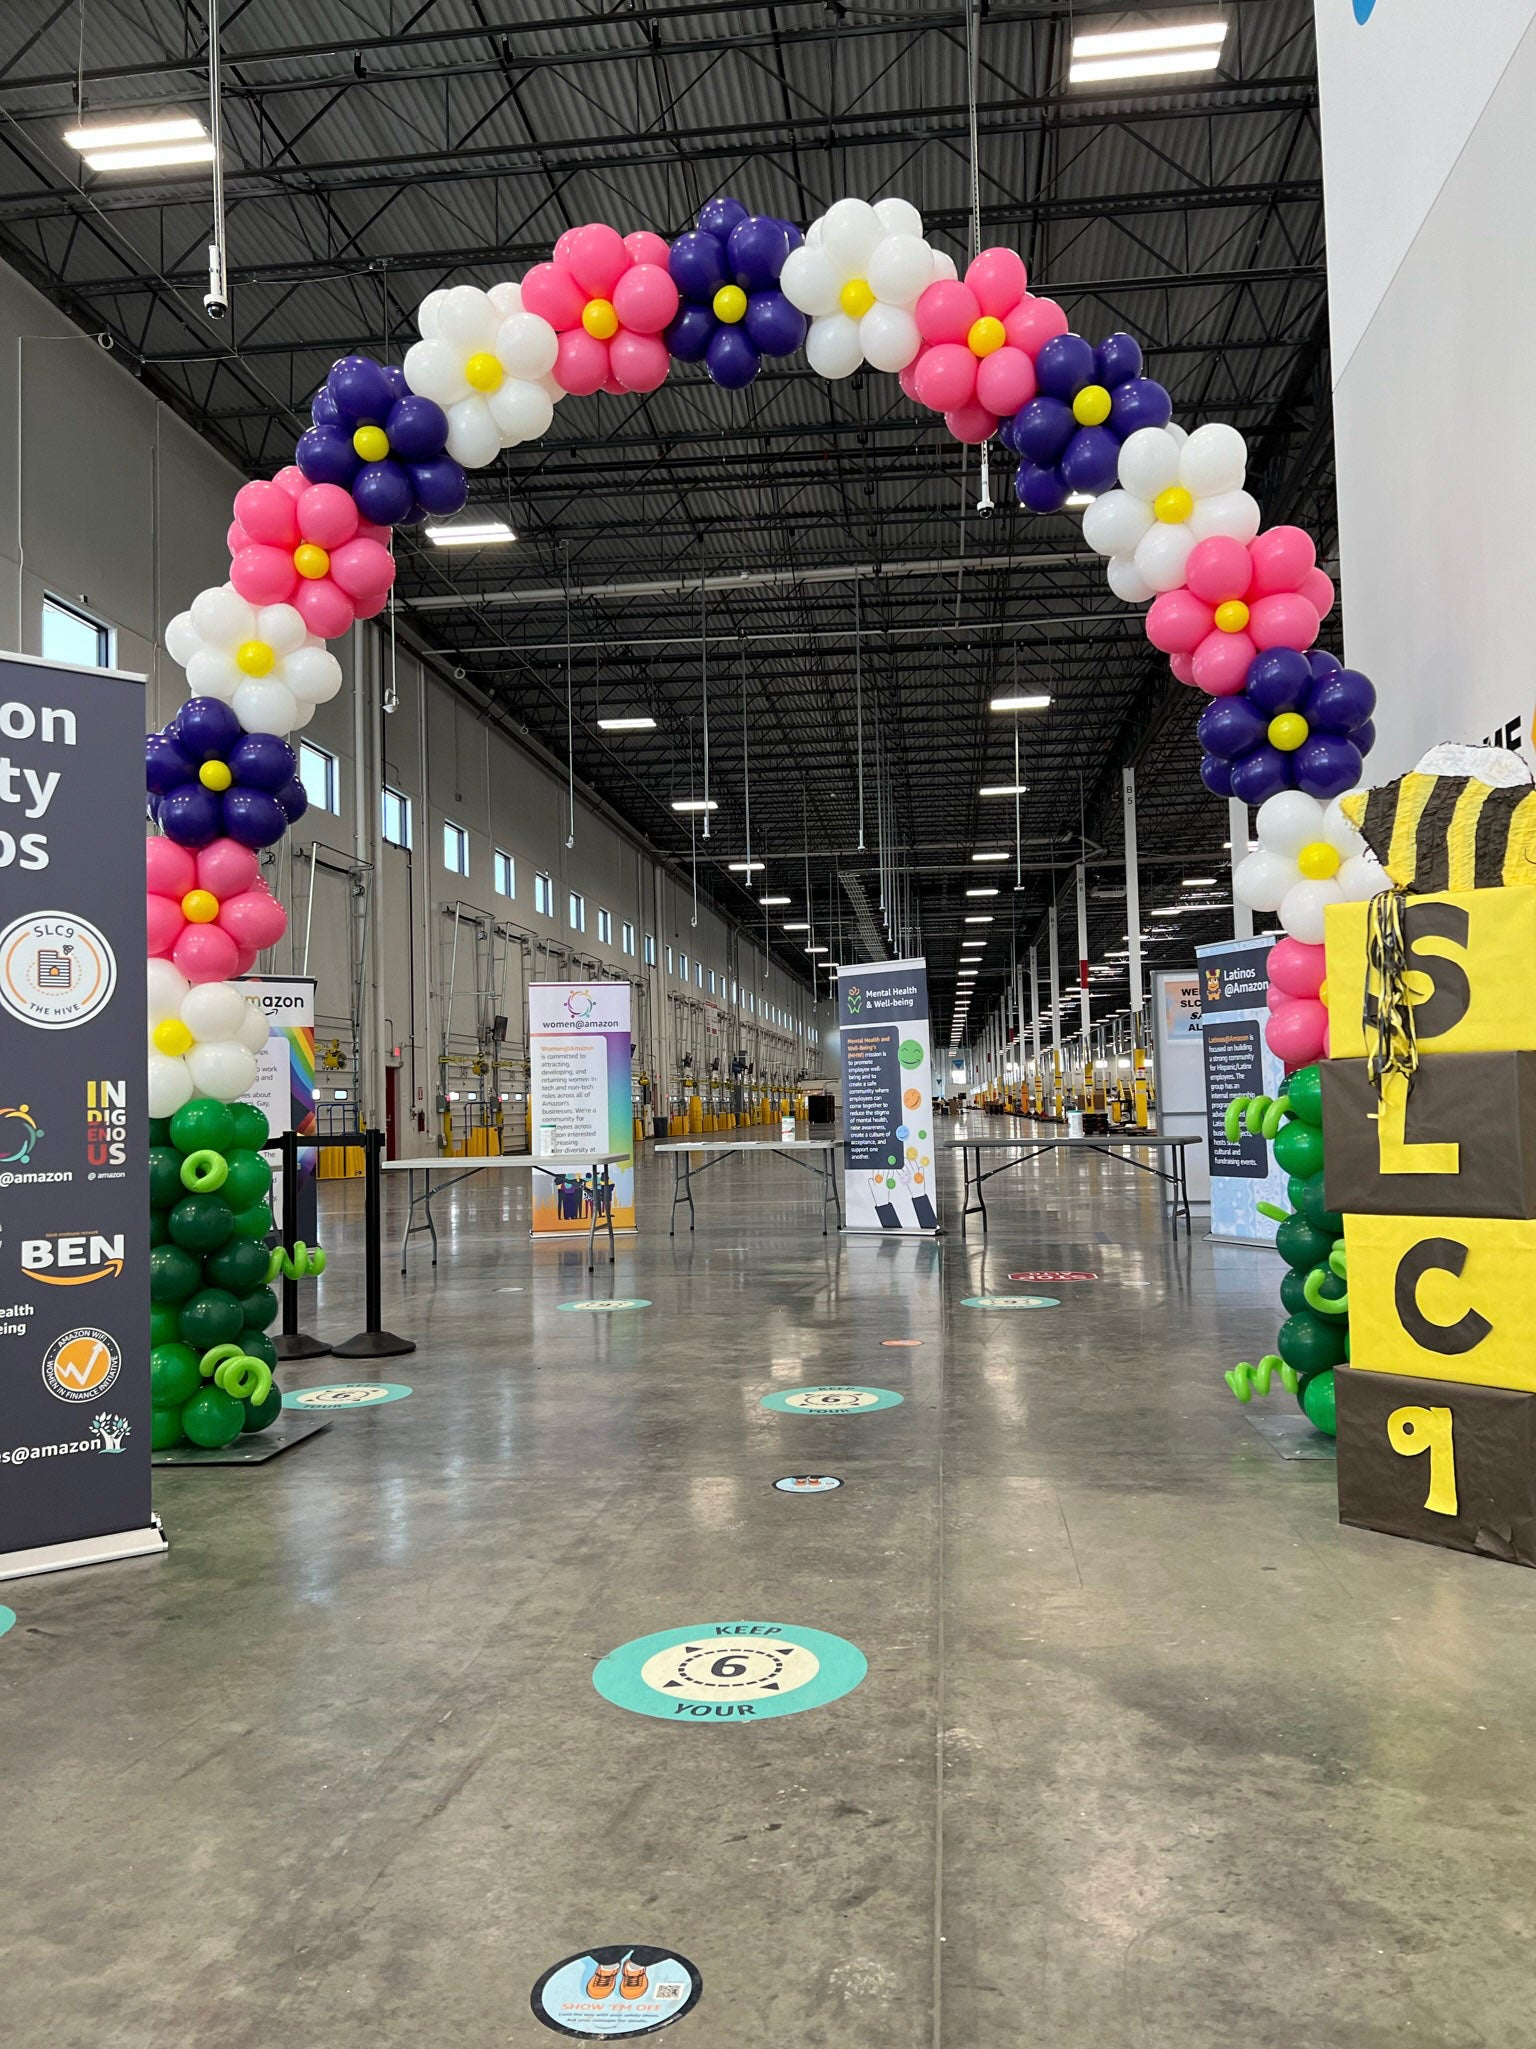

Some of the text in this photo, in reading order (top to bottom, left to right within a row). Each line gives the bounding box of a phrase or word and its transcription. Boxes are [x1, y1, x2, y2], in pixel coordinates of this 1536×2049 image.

[33, 924, 75, 939] SLC9
[1224, 968, 1256, 981] Latinos
[866, 986, 917, 998] Mental Health
[1224, 981, 1269, 997] @Amazon
[29, 1002, 80, 1016] THE HIVE
[866, 998, 914, 1009] & Well-being
[542, 1020, 619, 1030] women@amazon
[1379, 1068, 1460, 1175] L
[564, 1146, 588, 1154] diversity
[97, 1171, 126, 1179] amazon
[21, 1234, 125, 1270] BEN
[1394, 1237, 1493, 1355] C
[57, 1330, 108, 1348] AMAZON WIFI
[45, 1355, 119, 1400] WOMEN IN FINANCE INITIATIVE
[821, 1395, 841, 1403] 6
[0, 1439, 101, 1465] s@amazon
[1386, 1406, 1460, 1517] 9
[715, 1625, 783, 1636] KEEP
[710, 1655, 749, 1678] 6
[673, 1703, 757, 1717] YOUR
[560, 2003, 604, 2011] SHOW
[635, 2003, 662, 2012] OFF
